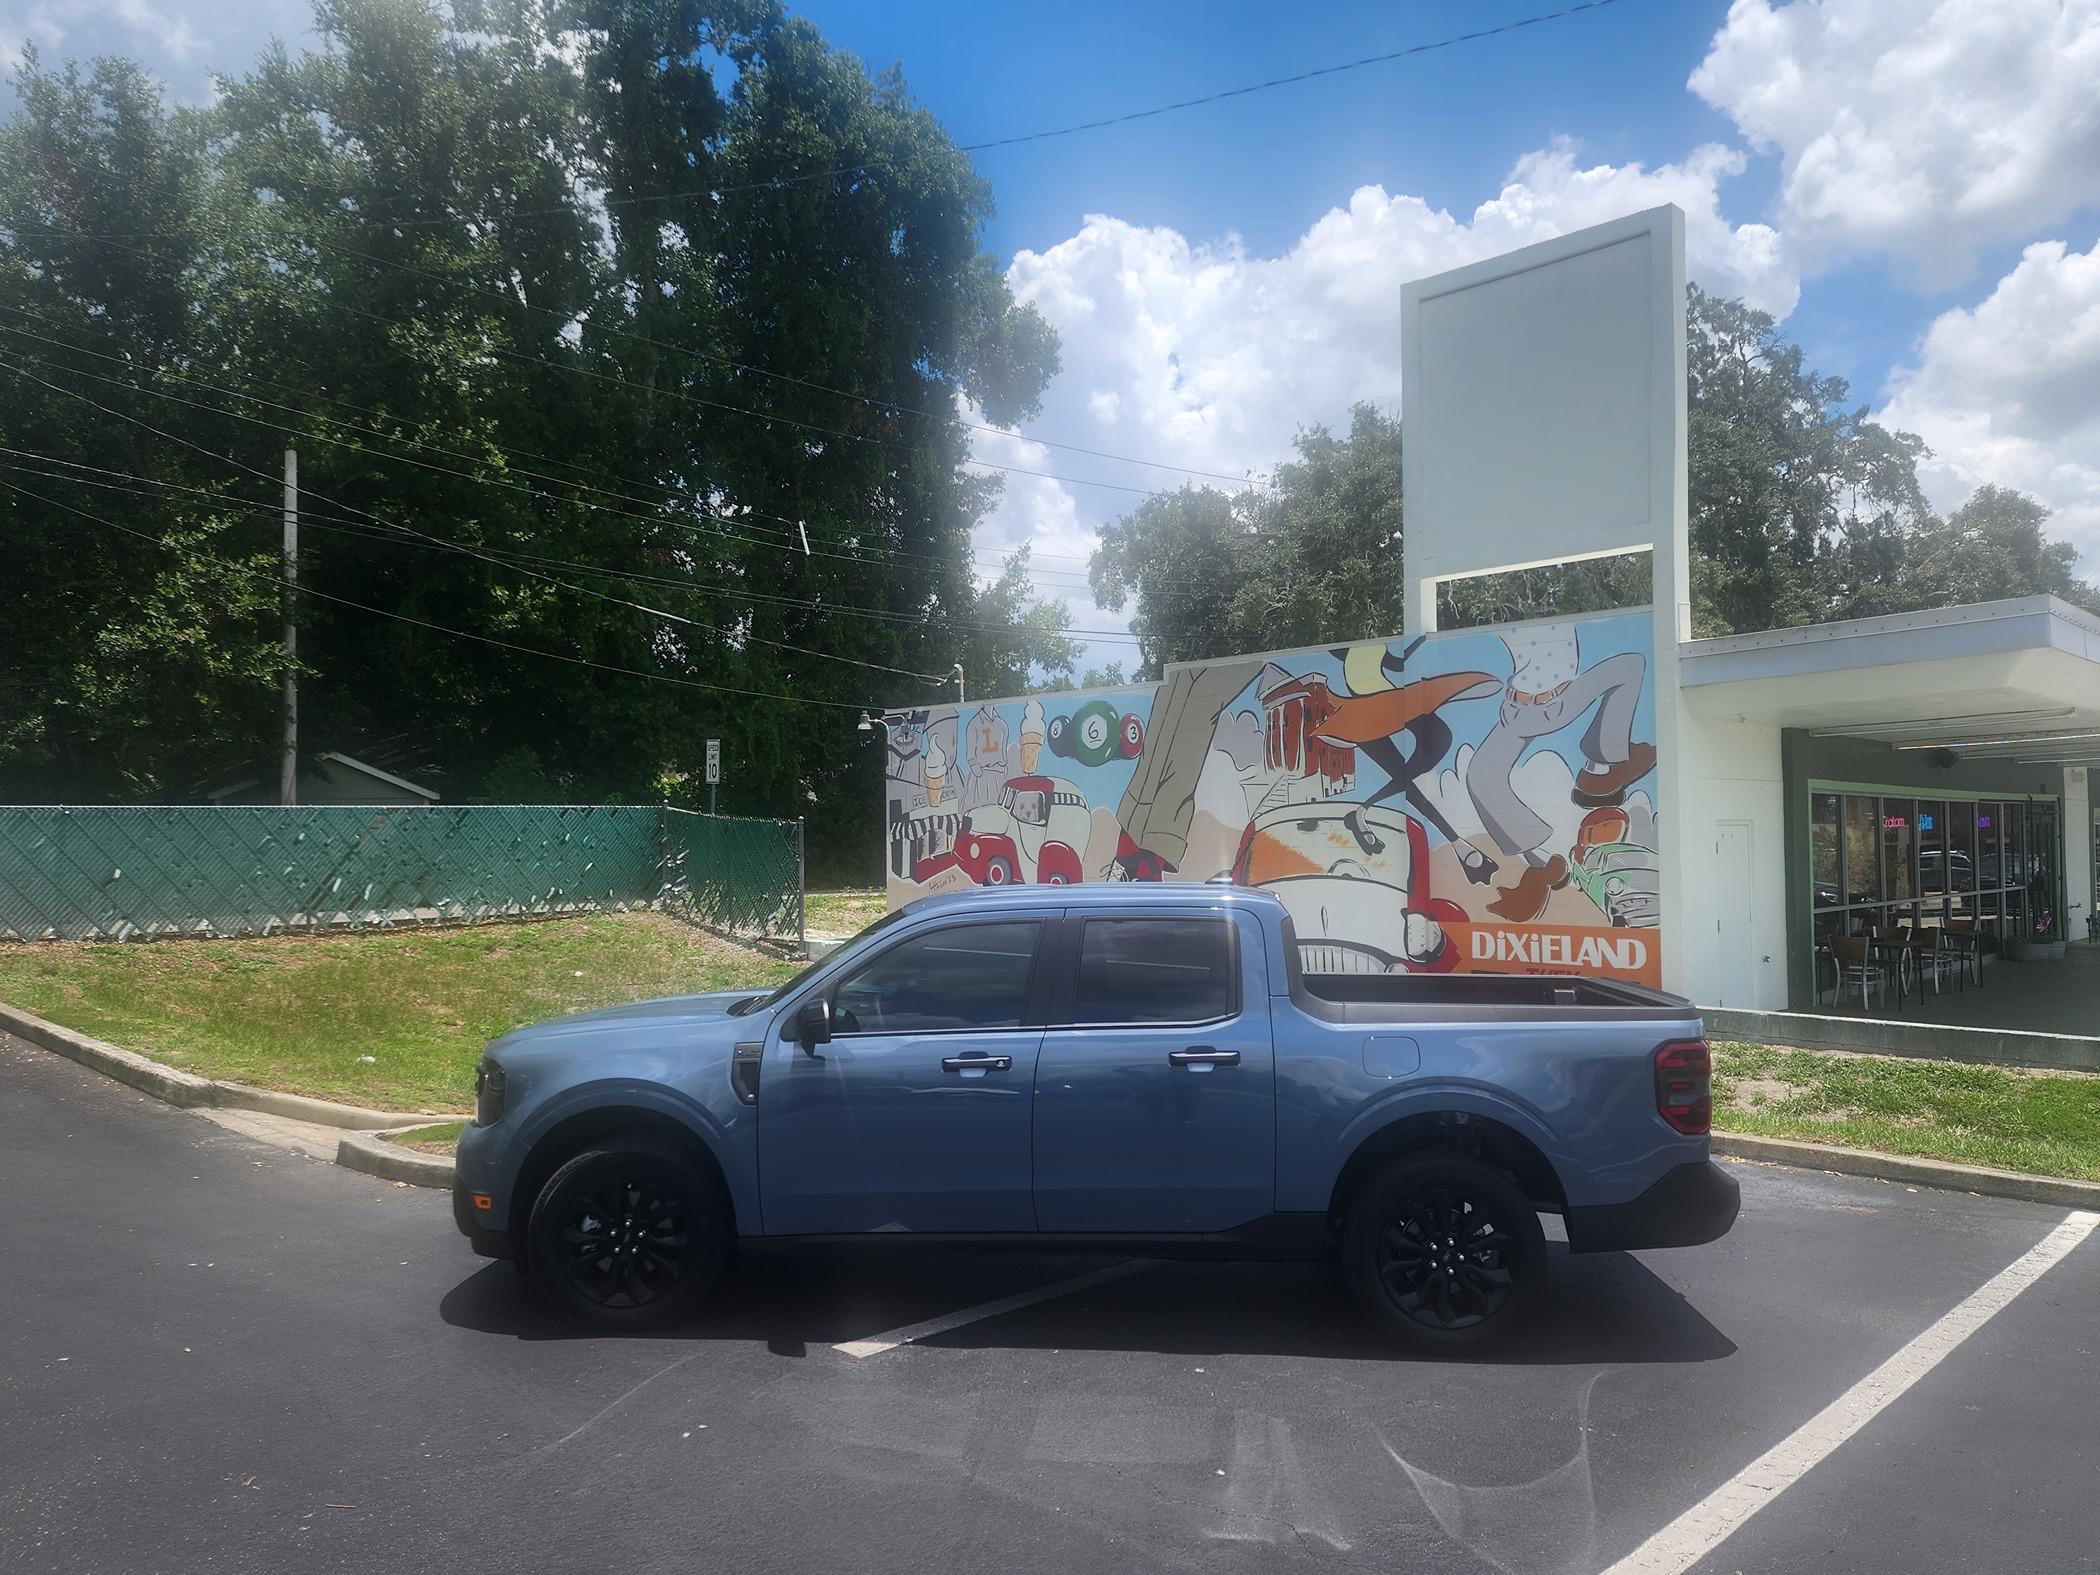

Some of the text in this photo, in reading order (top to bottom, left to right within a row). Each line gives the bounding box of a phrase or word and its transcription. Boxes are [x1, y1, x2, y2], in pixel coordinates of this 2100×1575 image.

[1052, 724, 1059, 736] 8
[1088, 720, 1099, 740] 6
[1130, 726, 1137, 740] 3
[982, 726, 999, 753] L
[708, 763, 718, 779] 10
